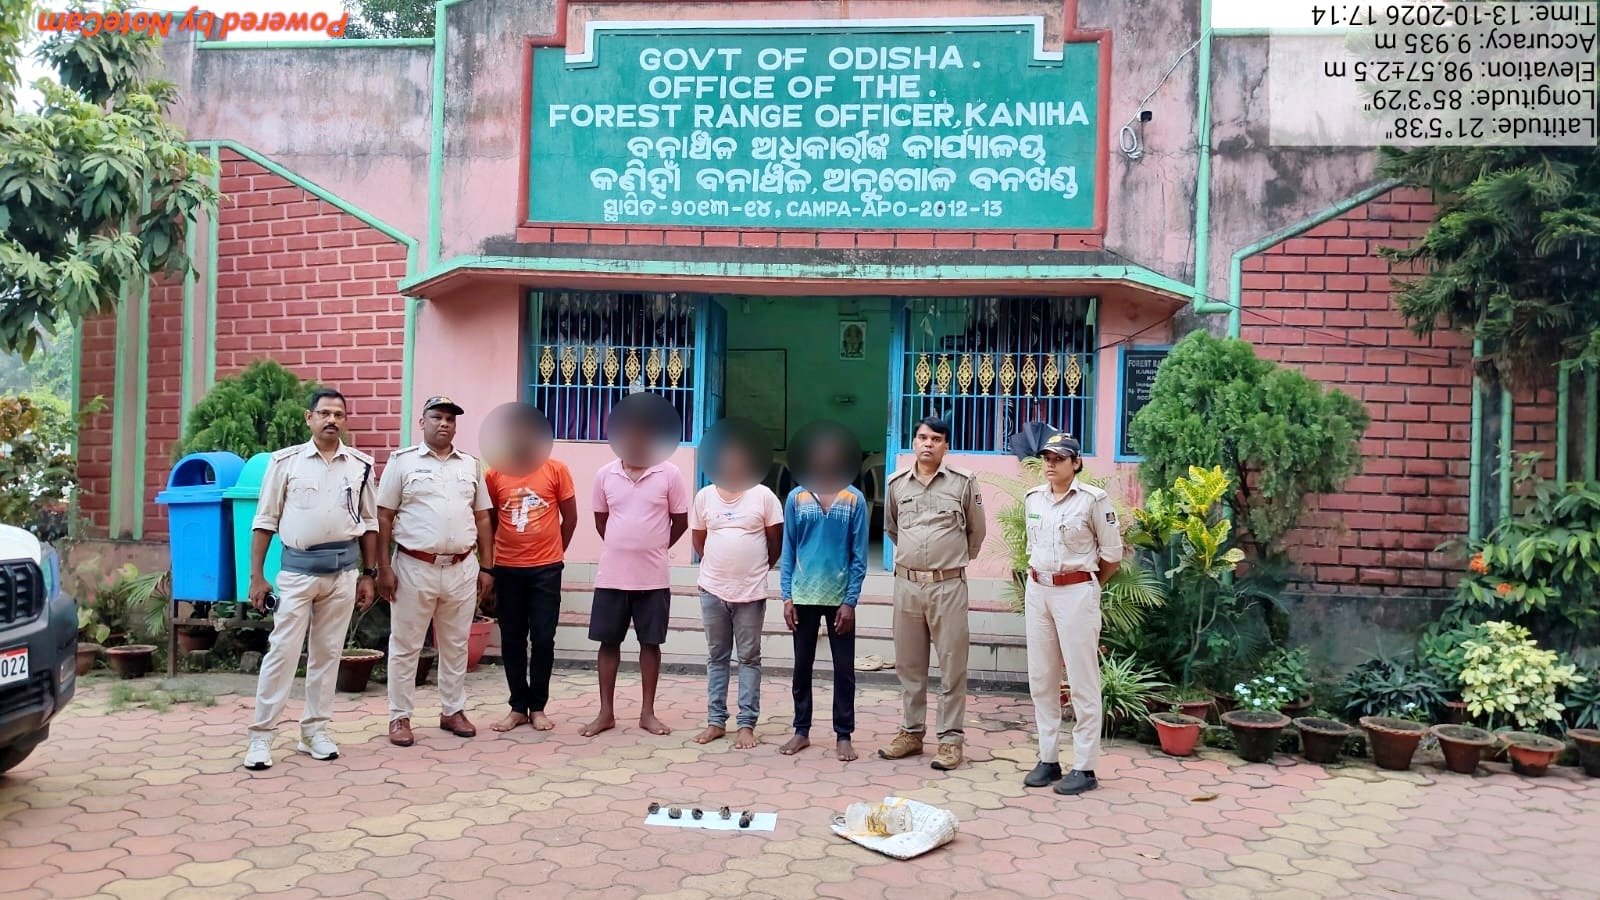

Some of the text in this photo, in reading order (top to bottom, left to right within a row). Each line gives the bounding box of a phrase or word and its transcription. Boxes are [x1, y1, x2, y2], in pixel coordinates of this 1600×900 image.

[639, 47, 742, 71] GOVT
[757, 47, 808, 71] OF
[648, 75, 775, 99] OFFICE
[787, 75, 836, 99] OF
[549, 104, 682, 128] FOREST
[697, 103, 802, 128] RANGE
[1, 655, 26, 678] 022
